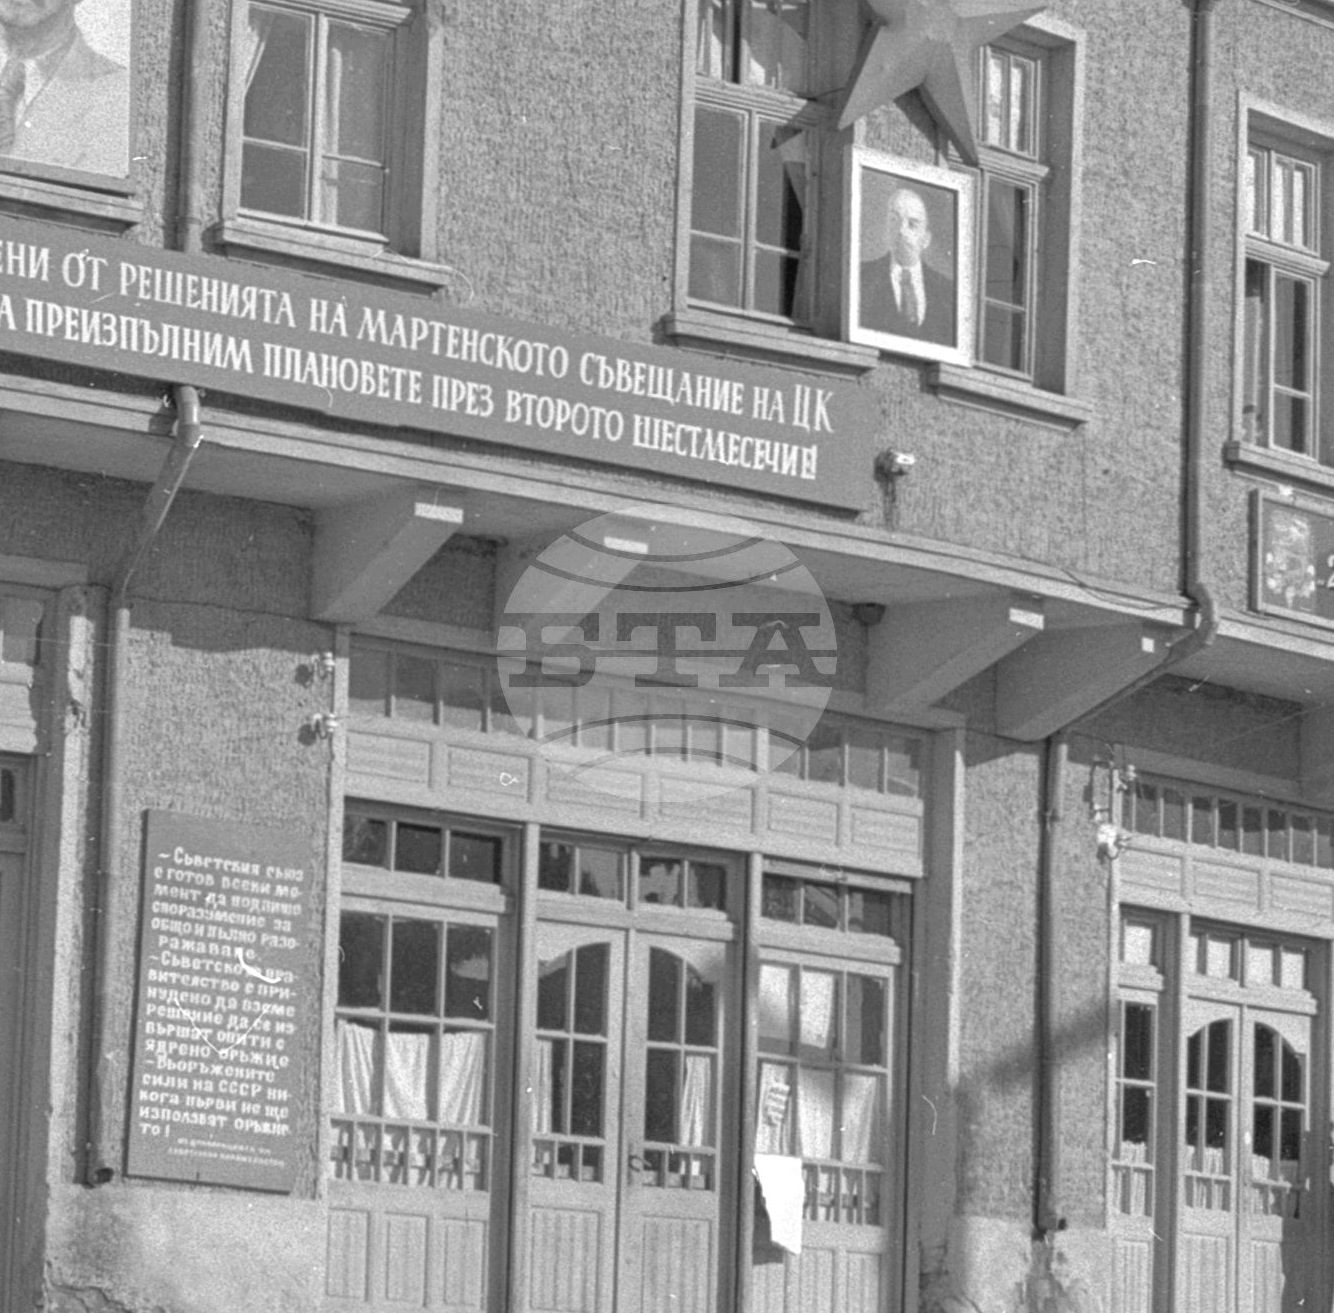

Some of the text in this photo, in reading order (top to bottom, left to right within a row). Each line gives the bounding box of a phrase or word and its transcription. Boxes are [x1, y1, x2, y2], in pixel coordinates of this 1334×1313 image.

[26, 299, 254, 375] ПРЕИЗПЪЛНИМ
[264, 343, 423, 404] ПЛАНОВЕТЕ
[432, 375, 495, 417] ПРЕЗ
[505, 390, 624, 442] ВТОРОТО
[63, 252, 107, 291] ОТ
[120, 262, 296, 328] РЕШЕНИЯТА
[308, 297, 348, 337] НА
[357, 307, 568, 379] МАРТЕНСКОТО
[579, 352, 744, 415] СЪВЕЩАНИЕ
[752, 386, 785, 424] НА
[792, 384, 835, 433] ЦК
